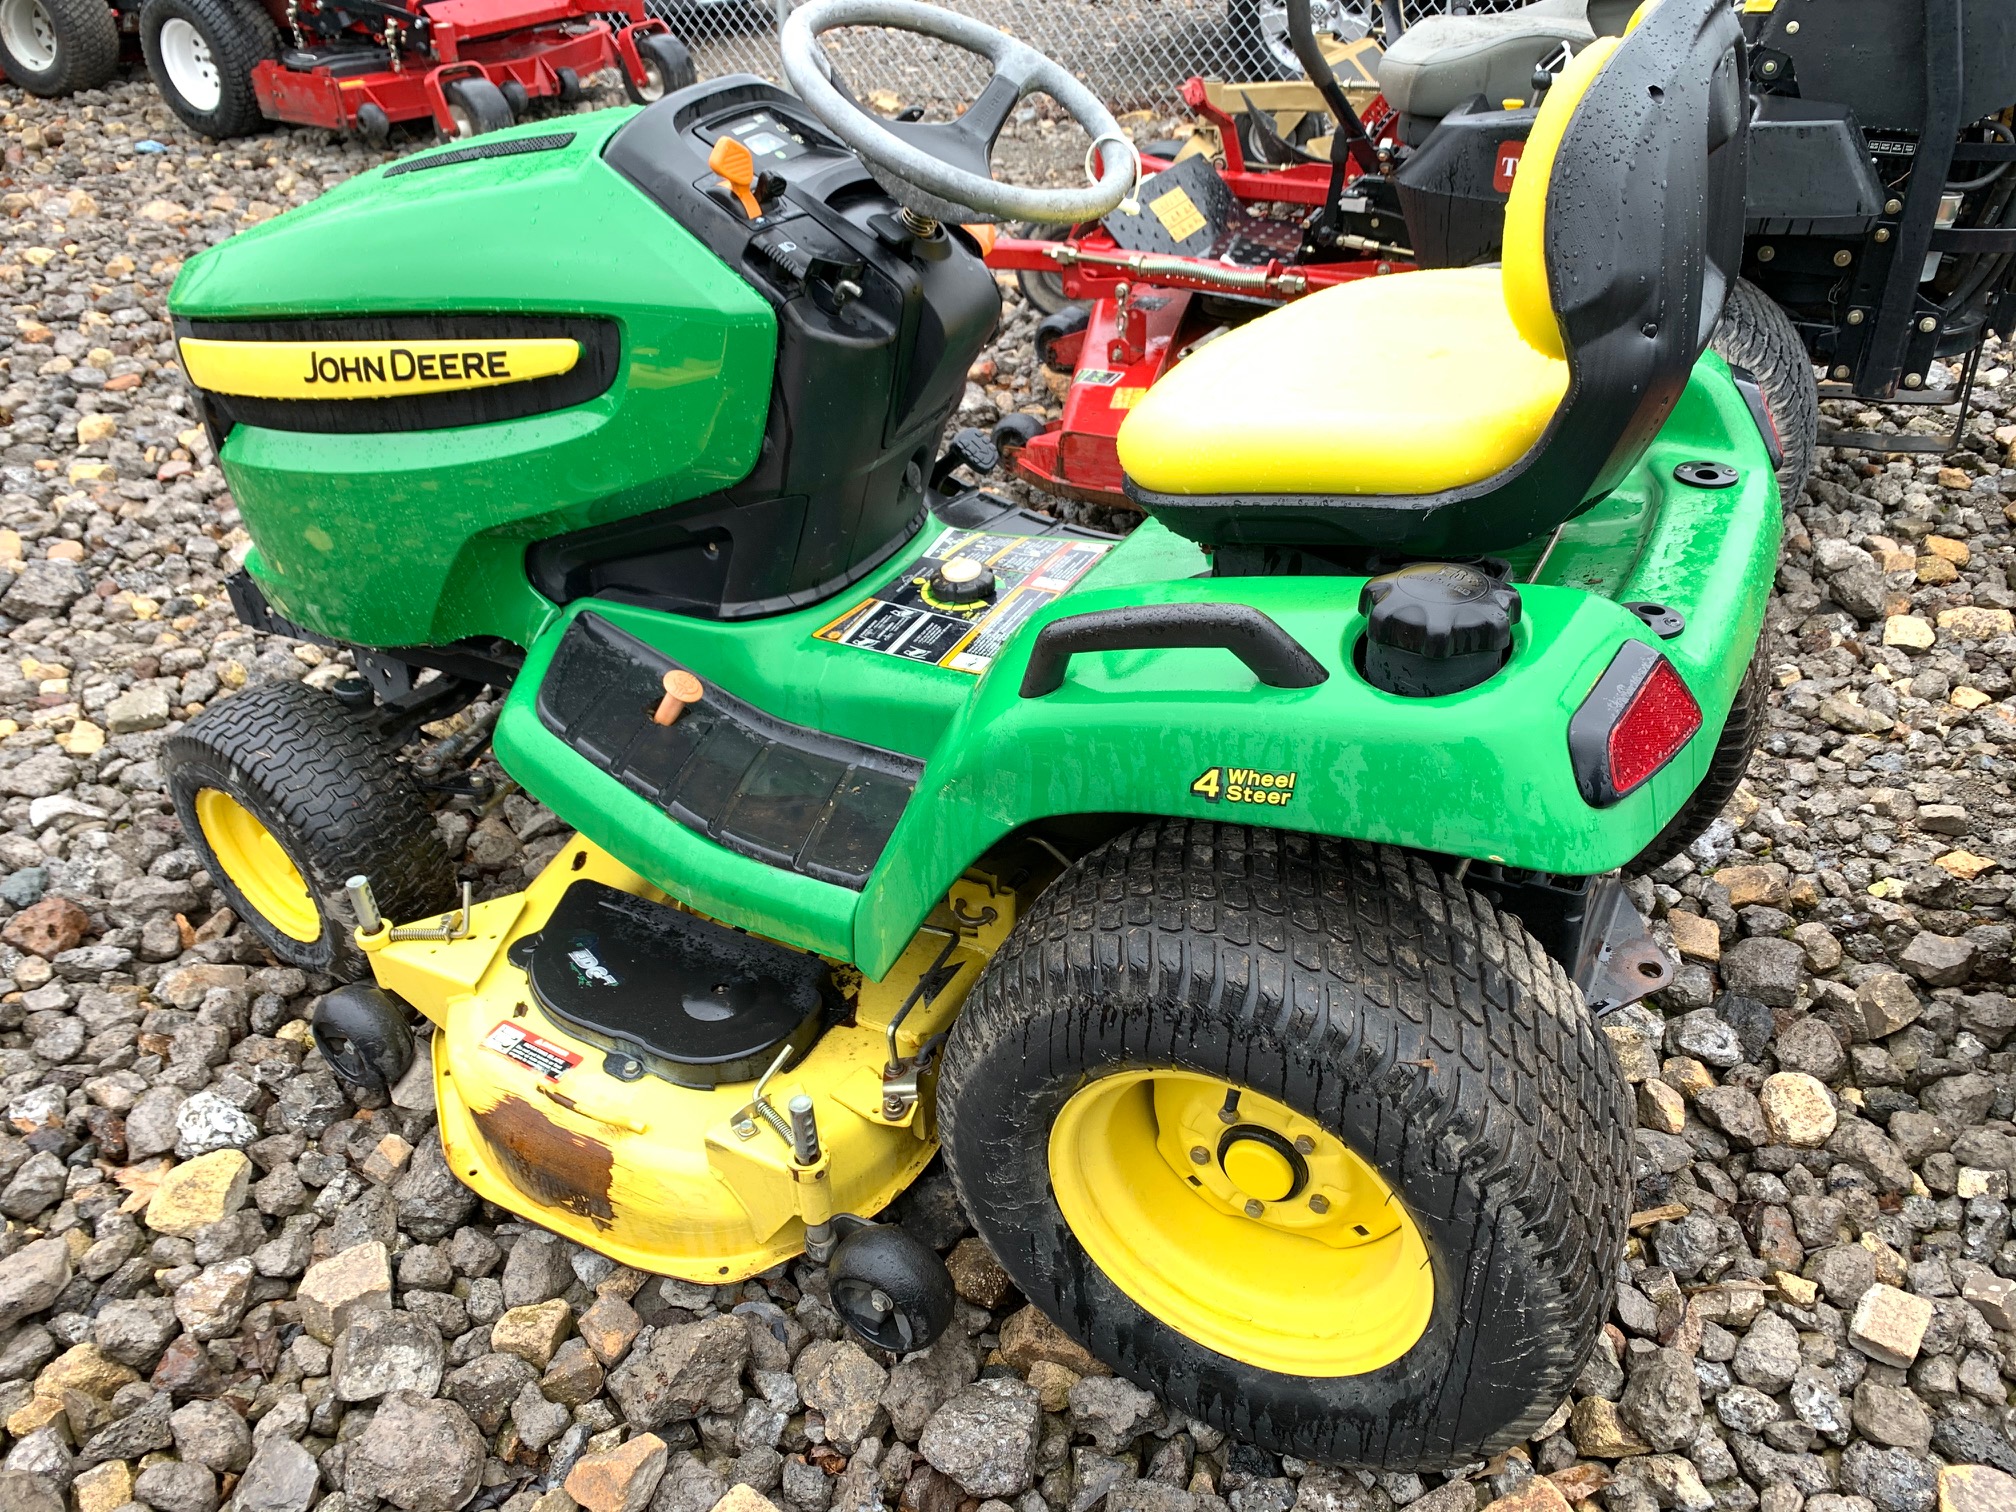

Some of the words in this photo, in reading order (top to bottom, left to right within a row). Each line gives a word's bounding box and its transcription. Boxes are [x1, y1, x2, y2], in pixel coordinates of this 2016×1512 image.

[304, 351, 387, 383] JOHN
[390, 348, 511, 381] DEERE
[1191, 767, 1221, 801] 4
[1226, 767, 1297, 790] Wheel
[1224, 784, 1293, 806] Steer
